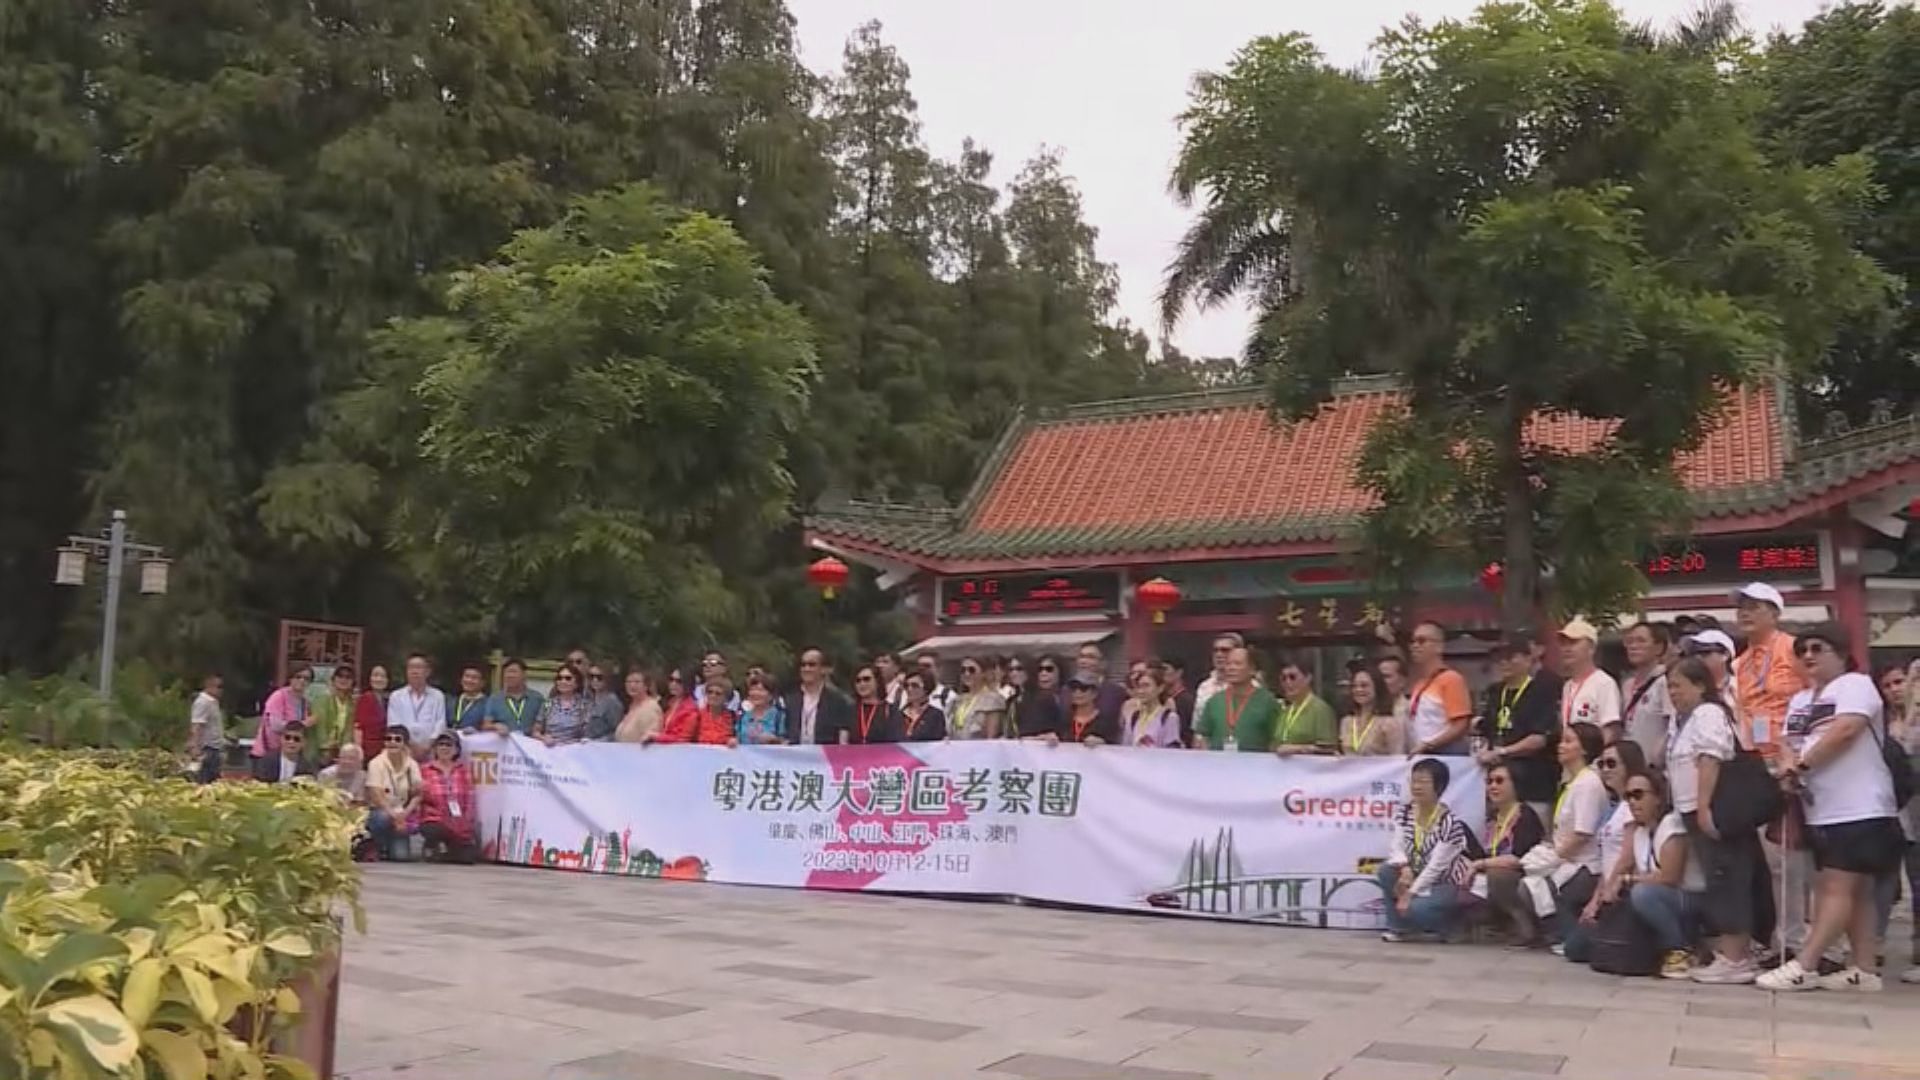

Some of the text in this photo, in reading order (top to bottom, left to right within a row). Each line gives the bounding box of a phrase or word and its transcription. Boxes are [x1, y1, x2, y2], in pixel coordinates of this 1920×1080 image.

[713, 768, 1082, 817] 粵港澳大灣區考察團
[1283, 789, 1398, 818] Greater
[802, 851, 971, 874] 2023年10月12-15日
